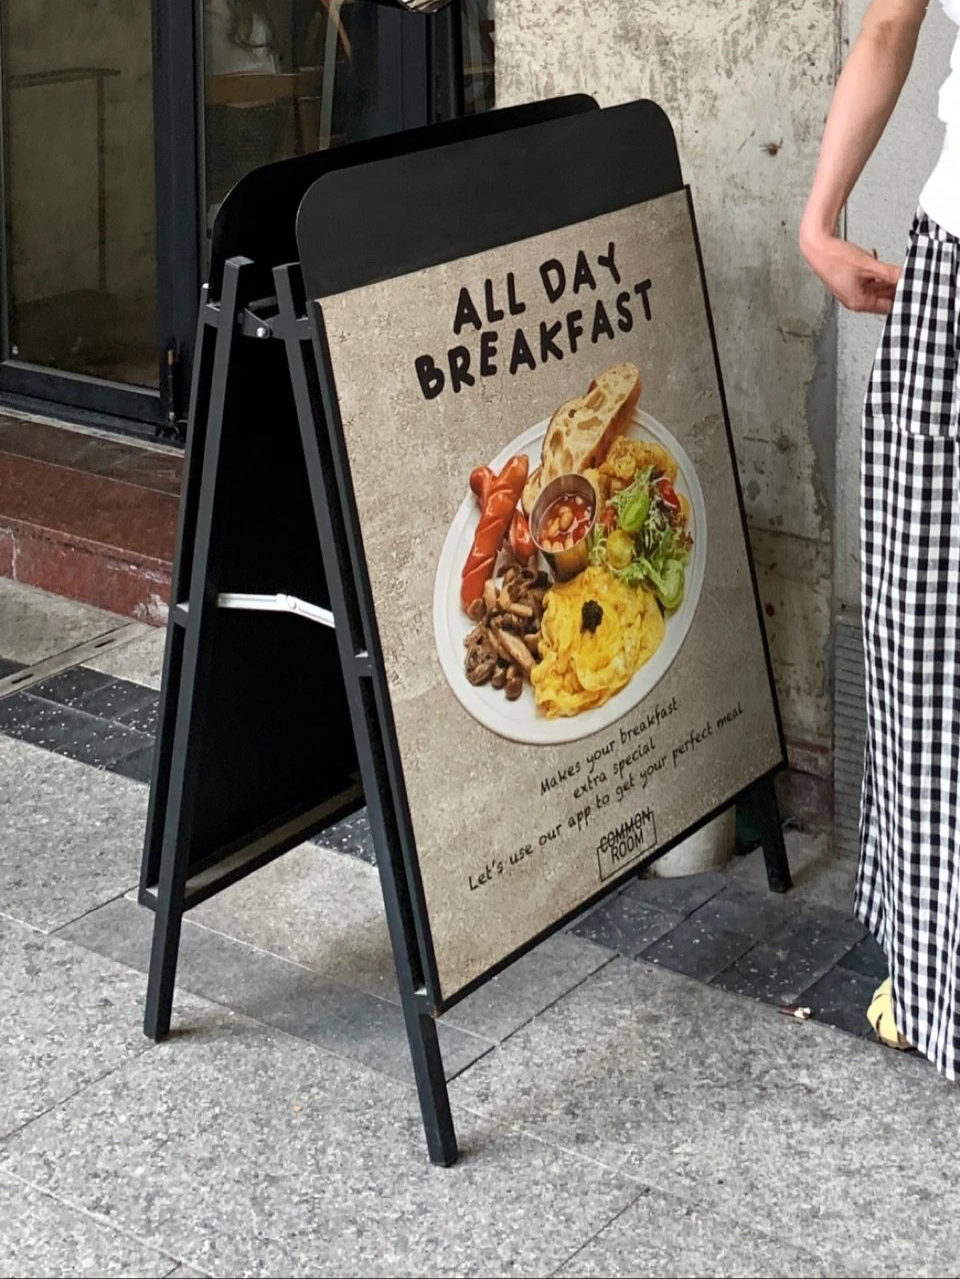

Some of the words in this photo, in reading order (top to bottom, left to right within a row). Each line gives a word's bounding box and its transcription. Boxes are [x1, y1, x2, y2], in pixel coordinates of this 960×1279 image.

[453, 272, 526, 335] ALL
[539, 242, 621, 304] DAY
[414, 278, 652, 400] BREAKFAST
[540, 761, 581, 796] Makes
[586, 740, 616, 774] your
[619, 697, 679, 745] breakfast
[573, 771, 608, 799] extra
[613, 736, 656, 780] special
[468, 859, 504, 891] Let's
[509, 843, 534, 865] use
[539, 823, 562, 846] our
[567, 806, 592, 832] app
[595, 794, 610, 809] to
[615, 773, 636, 802] get
[640, 755, 668, 789] your
[672, 722, 713, 769] perfect
[716, 701, 744, 729] meal
[600, 806, 651, 853] COMMON
[611, 828, 644, 864] ROOM
